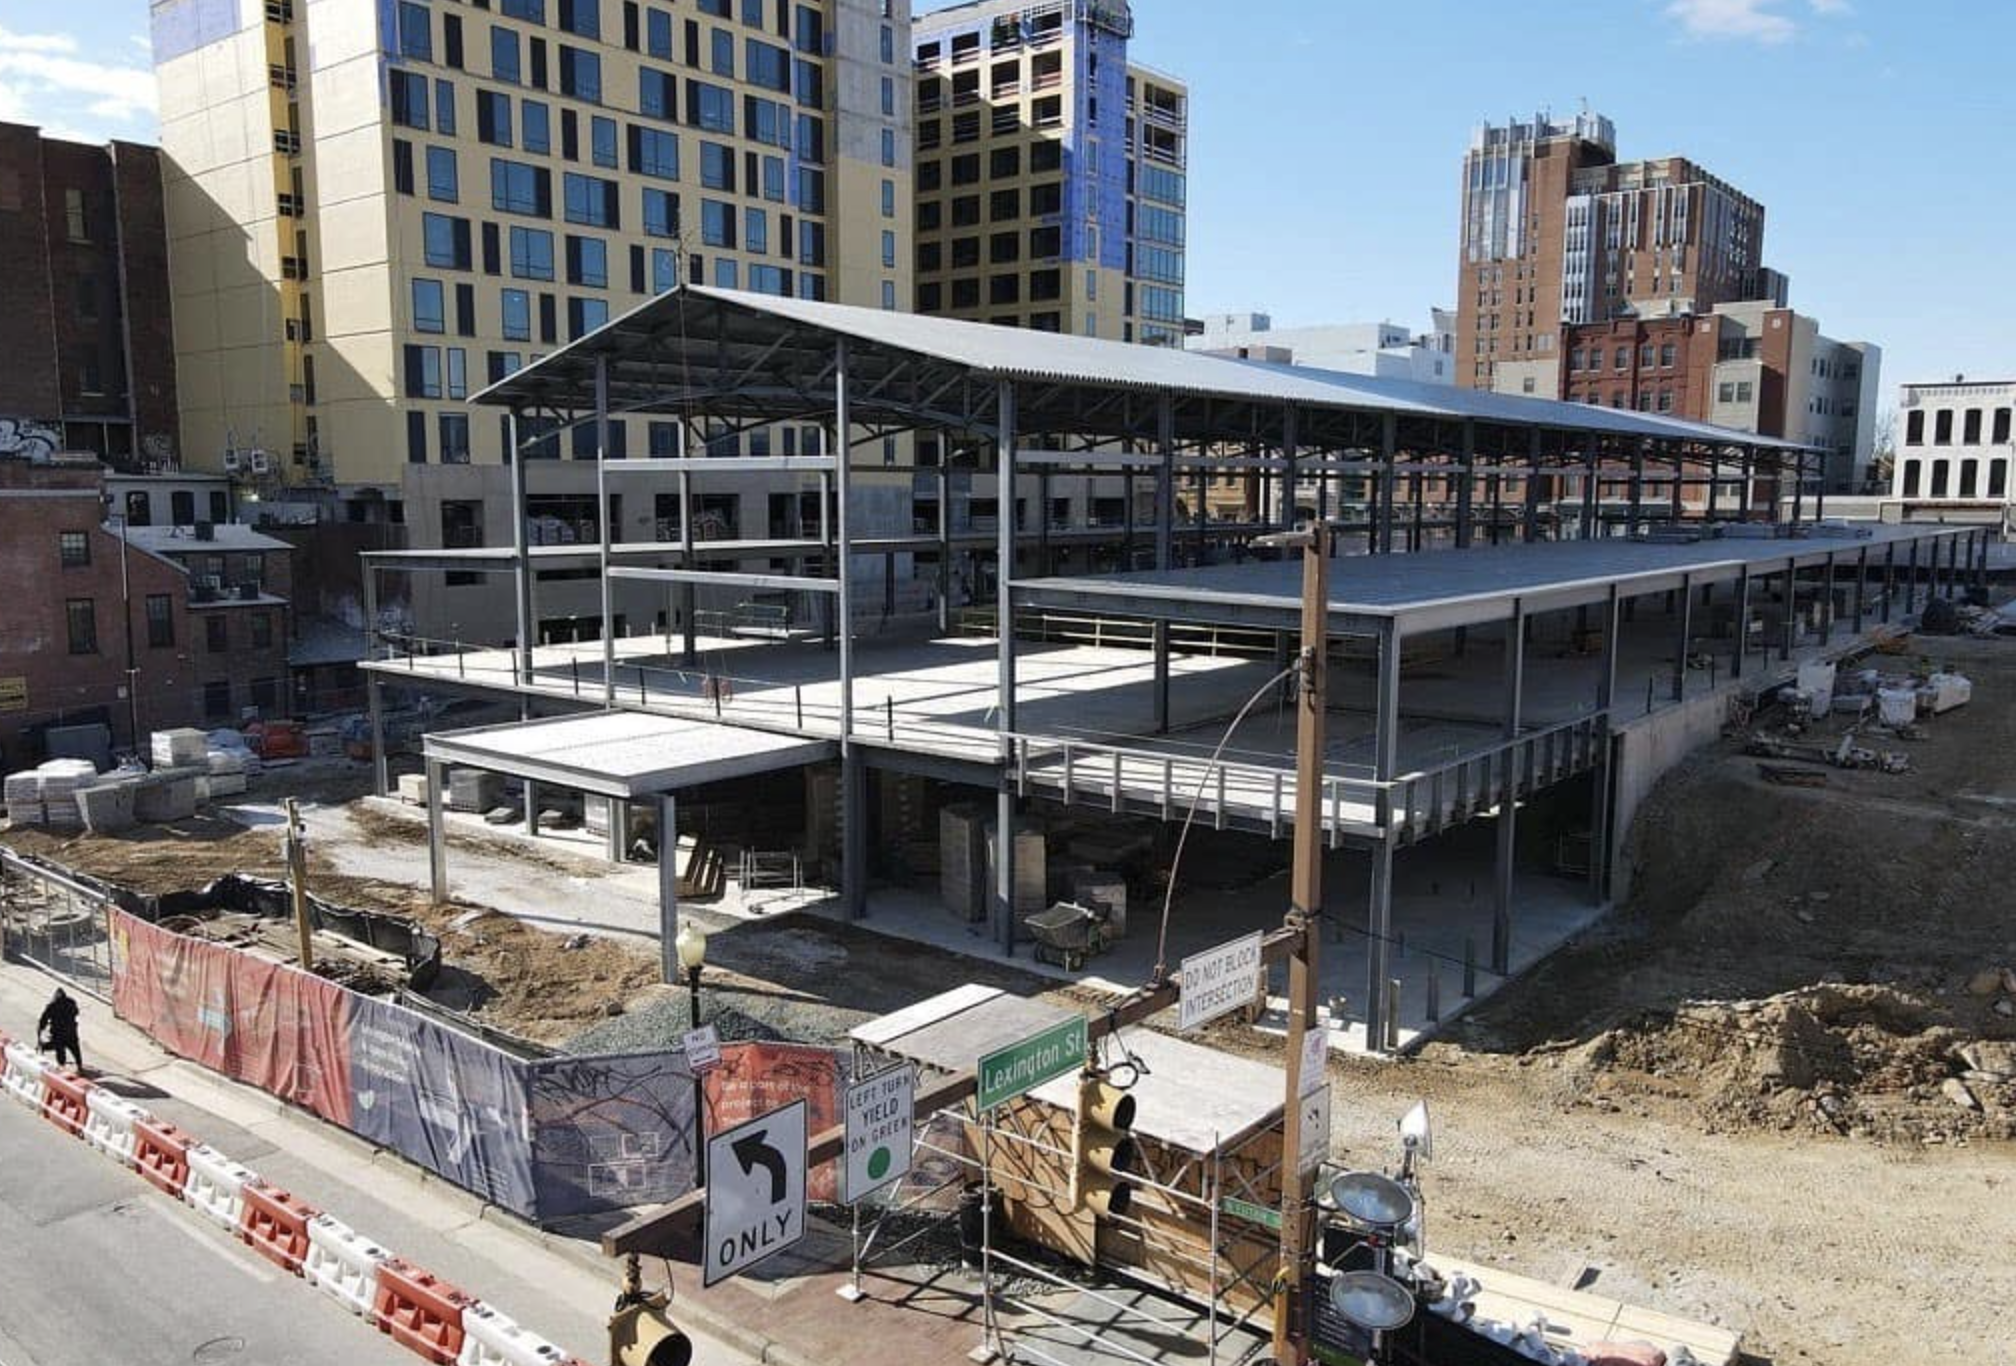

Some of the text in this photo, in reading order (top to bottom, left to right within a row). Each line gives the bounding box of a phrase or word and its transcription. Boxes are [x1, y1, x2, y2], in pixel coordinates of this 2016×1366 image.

[1185, 942, 1257, 991] DO NOT BLOCK
[1185, 972, 1255, 1018] INTERSECTION
[985, 1030, 1082, 1093] Lexington St
[850, 1074, 909, 1110] LEFT TURN
[863, 1097, 899, 1128] YIELD
[851, 1116, 908, 1153] ON GREEN
[720, 1209, 792, 1267] ONLY
